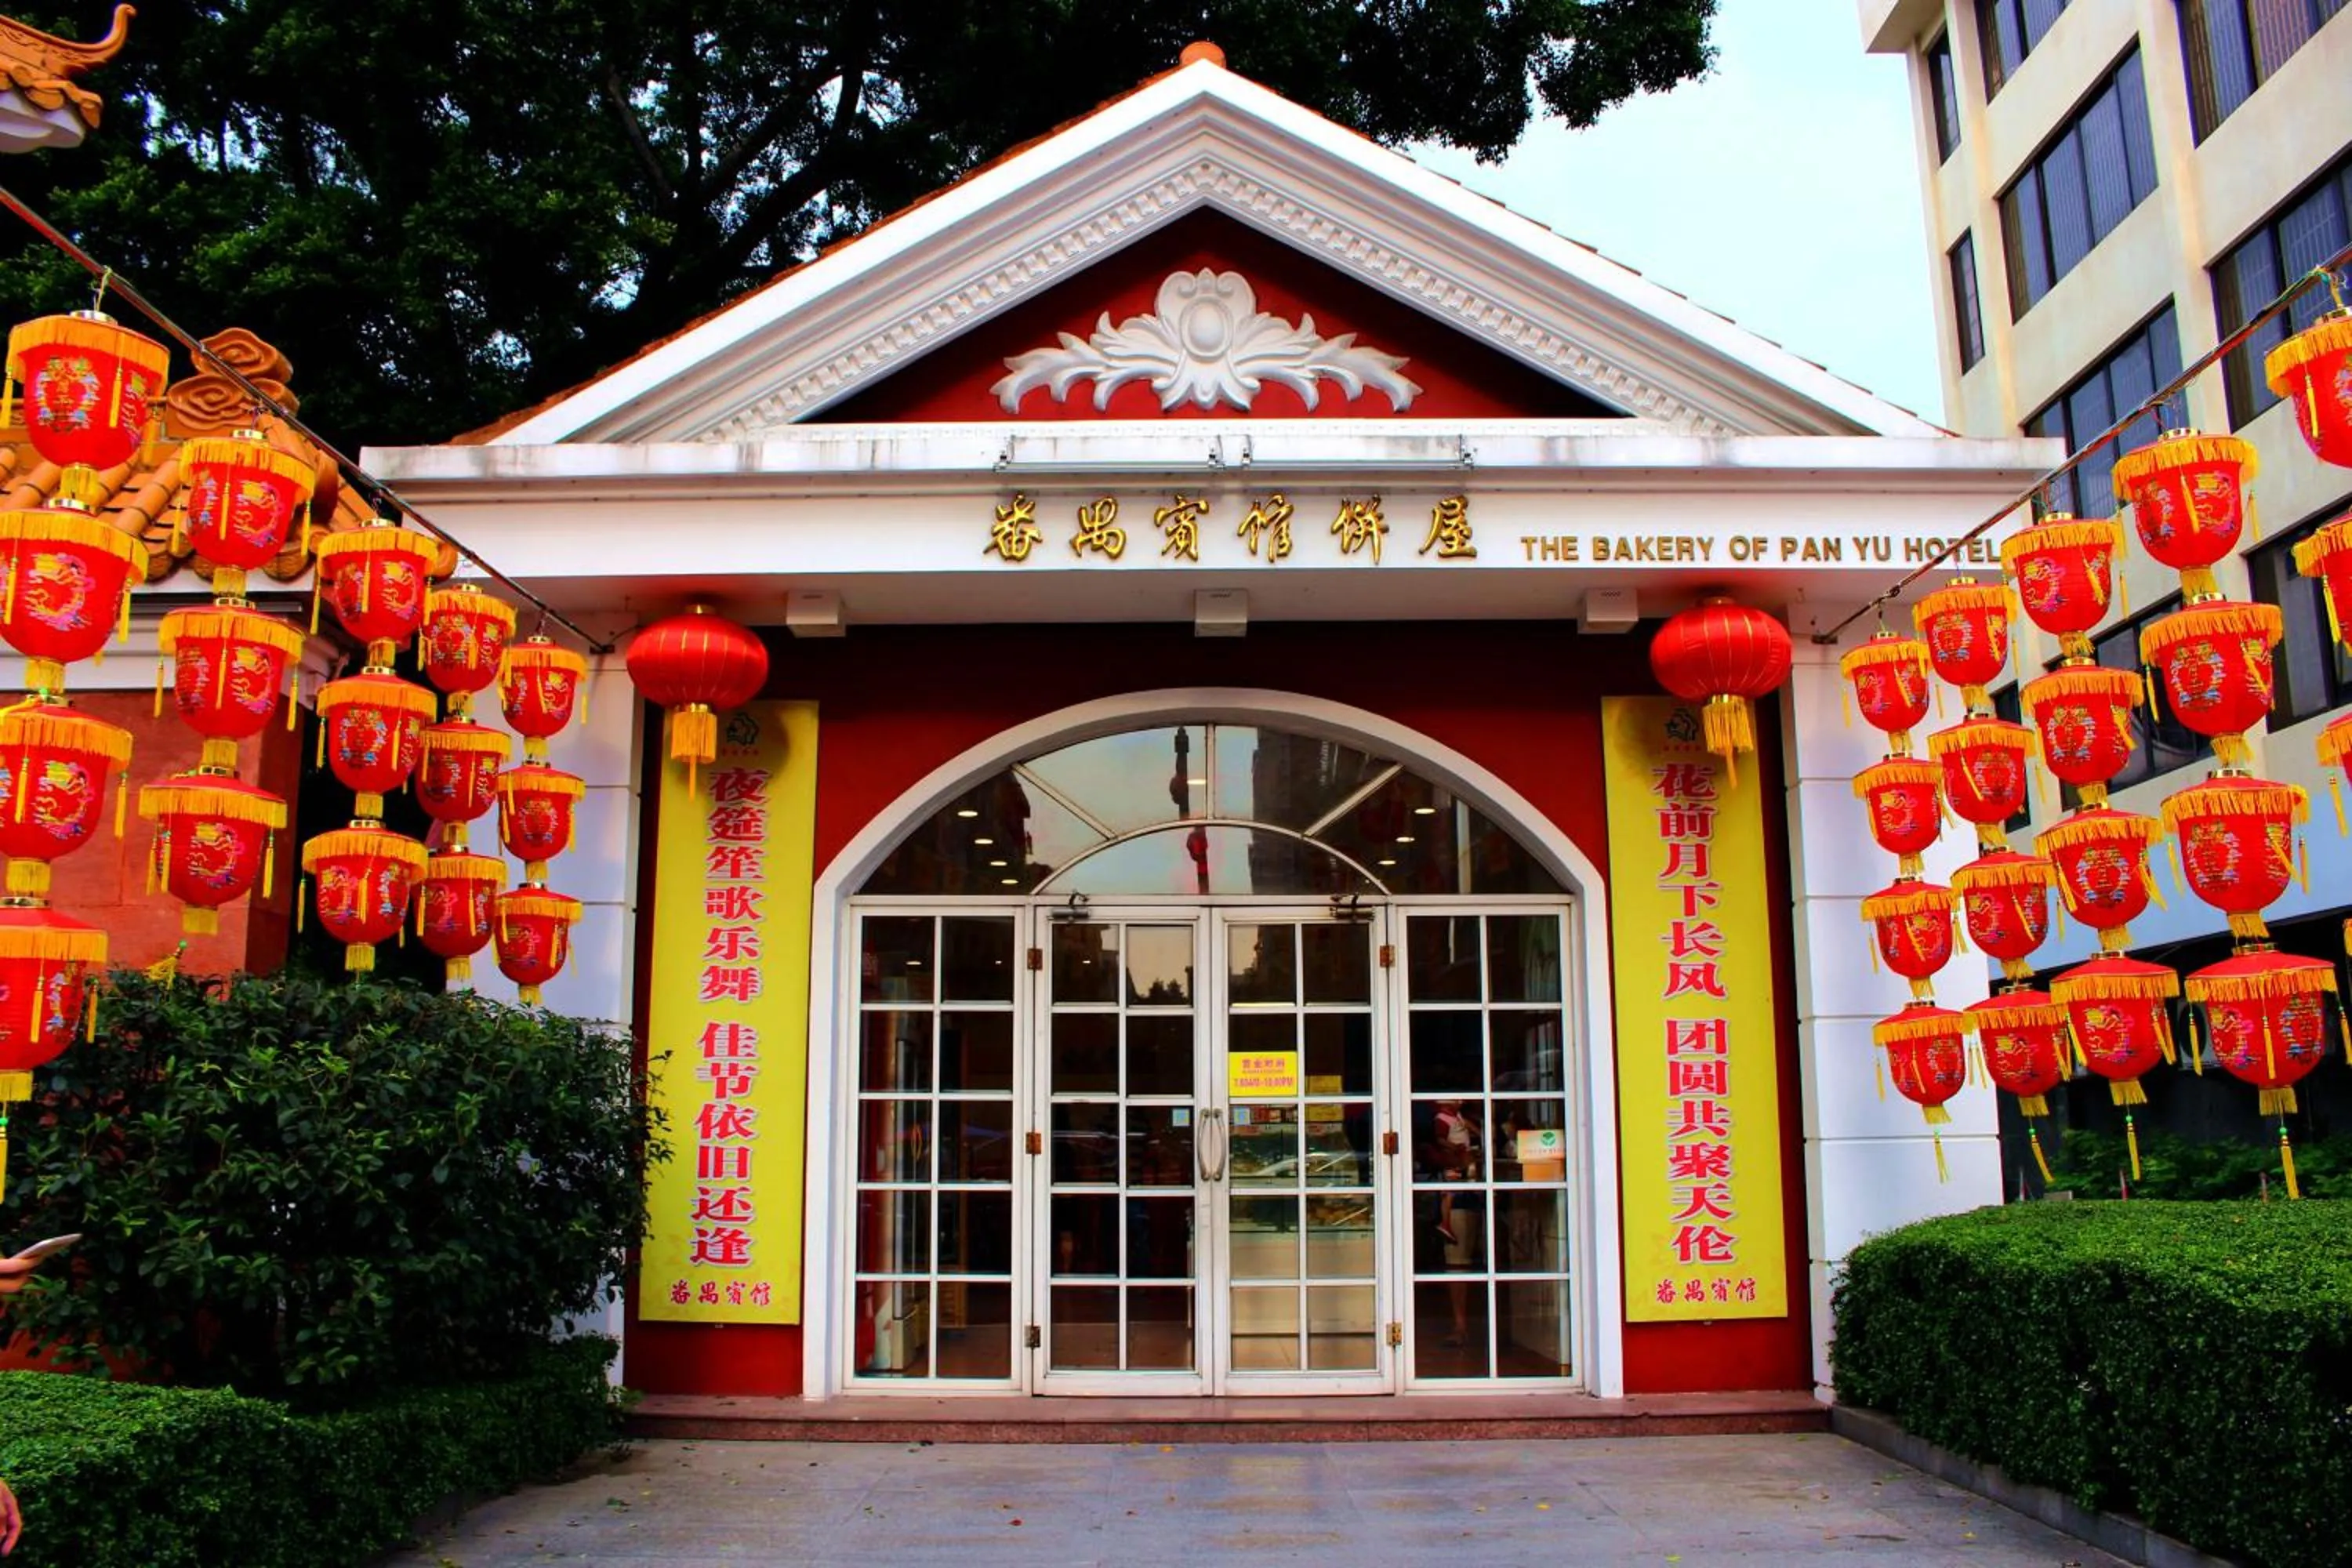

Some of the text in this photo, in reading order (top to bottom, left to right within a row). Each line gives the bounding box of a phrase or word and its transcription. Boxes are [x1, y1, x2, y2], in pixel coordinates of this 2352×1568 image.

[1522, 536, 2002, 562] THE BAKERY OF PAN YU HOTEL
[1653, 763, 1736, 1263] 花前月下长风 团圆共聚天伦
[689, 1022, 759, 1265] 佳节依旧还逢
